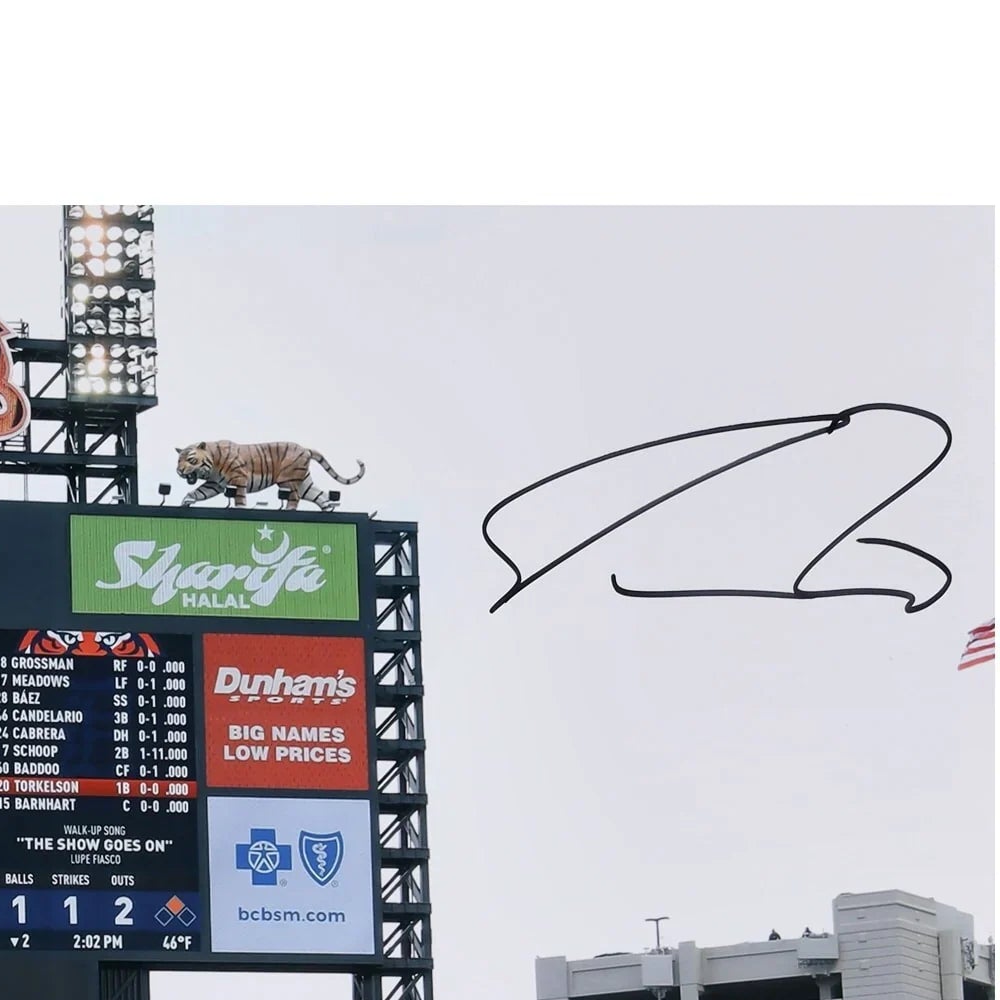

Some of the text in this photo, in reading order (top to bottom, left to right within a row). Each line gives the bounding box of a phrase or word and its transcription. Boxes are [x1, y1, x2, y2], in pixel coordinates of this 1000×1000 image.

[96, 531, 327, 606] Sharifa
[182, 592, 250, 609] HALAL
[11, 657, 74, 670] GROSSMAN
[12, 674, 70, 687] MEADOWS
[214, 666, 357, 697] Dunham's
[12, 689, 40, 705] BÁEZ
[229, 695, 347, 706] SPORTS
[12, 710, 83, 723] CANDELARIO
[13, 727, 66, 741] CABRERA
[229, 725, 345, 743] BIG NAMES
[13, 745, 58, 758] SCHOOP
[224, 745, 351, 763] LOW PRICES
[14, 762, 60, 775] BADDOO
[14, 780, 79, 793] TORKELSON
[15, 797, 76, 811] BARNHART
[64, 825, 126, 836] WALK-UP SONG
[56, 838, 99, 851] SHOW
[104, 839, 141, 852] GOES
[71, 854, 121, 865] LUPE FIASCO
[5, 873, 135, 886] BALLS STRIKES OUTS
[238, 906, 346, 923] bcbsm.com
[73, 934, 123, 949] 2:02 PM
[163, 935, 192, 950] 46°F
